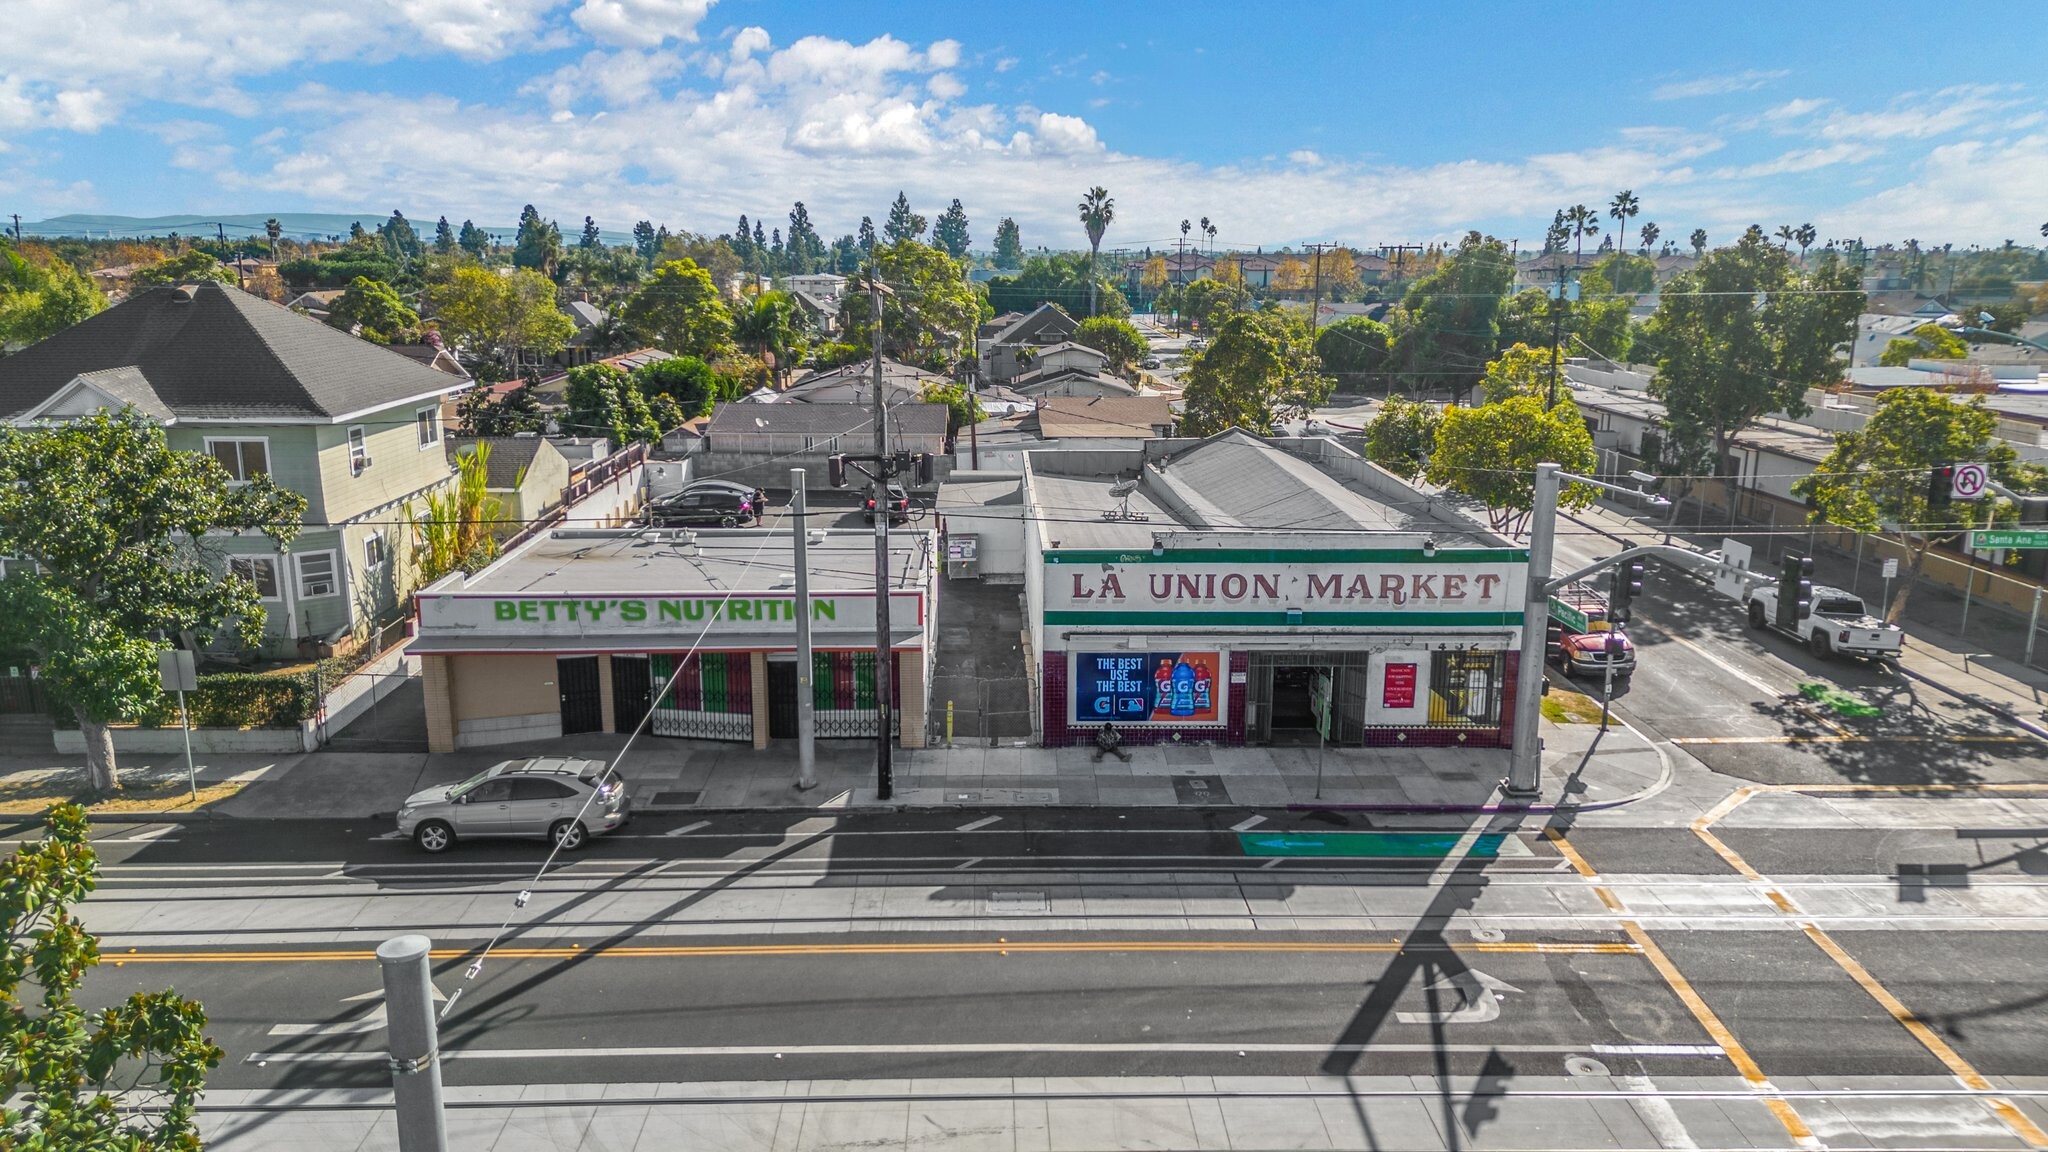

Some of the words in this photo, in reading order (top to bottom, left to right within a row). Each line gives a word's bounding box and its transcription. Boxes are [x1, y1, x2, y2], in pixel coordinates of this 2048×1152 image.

[1990, 535, 2013, 544] Santa
[2016, 536, 2032, 544] Ana
[1071, 573, 1127, 600] LA
[1148, 573, 1281, 601] UNION
[1306, 573, 1501, 606] MARKET
[495, 600, 648, 622] BETTY'S
[1097, 658, 1116, 670] THE
[1118, 658, 1143, 670] BEST
[1110, 669, 1129, 681] USE
[1096, 680, 1116, 693] THE
[1117, 680, 1143, 693] BEST
[1094, 696, 1111, 714] G
